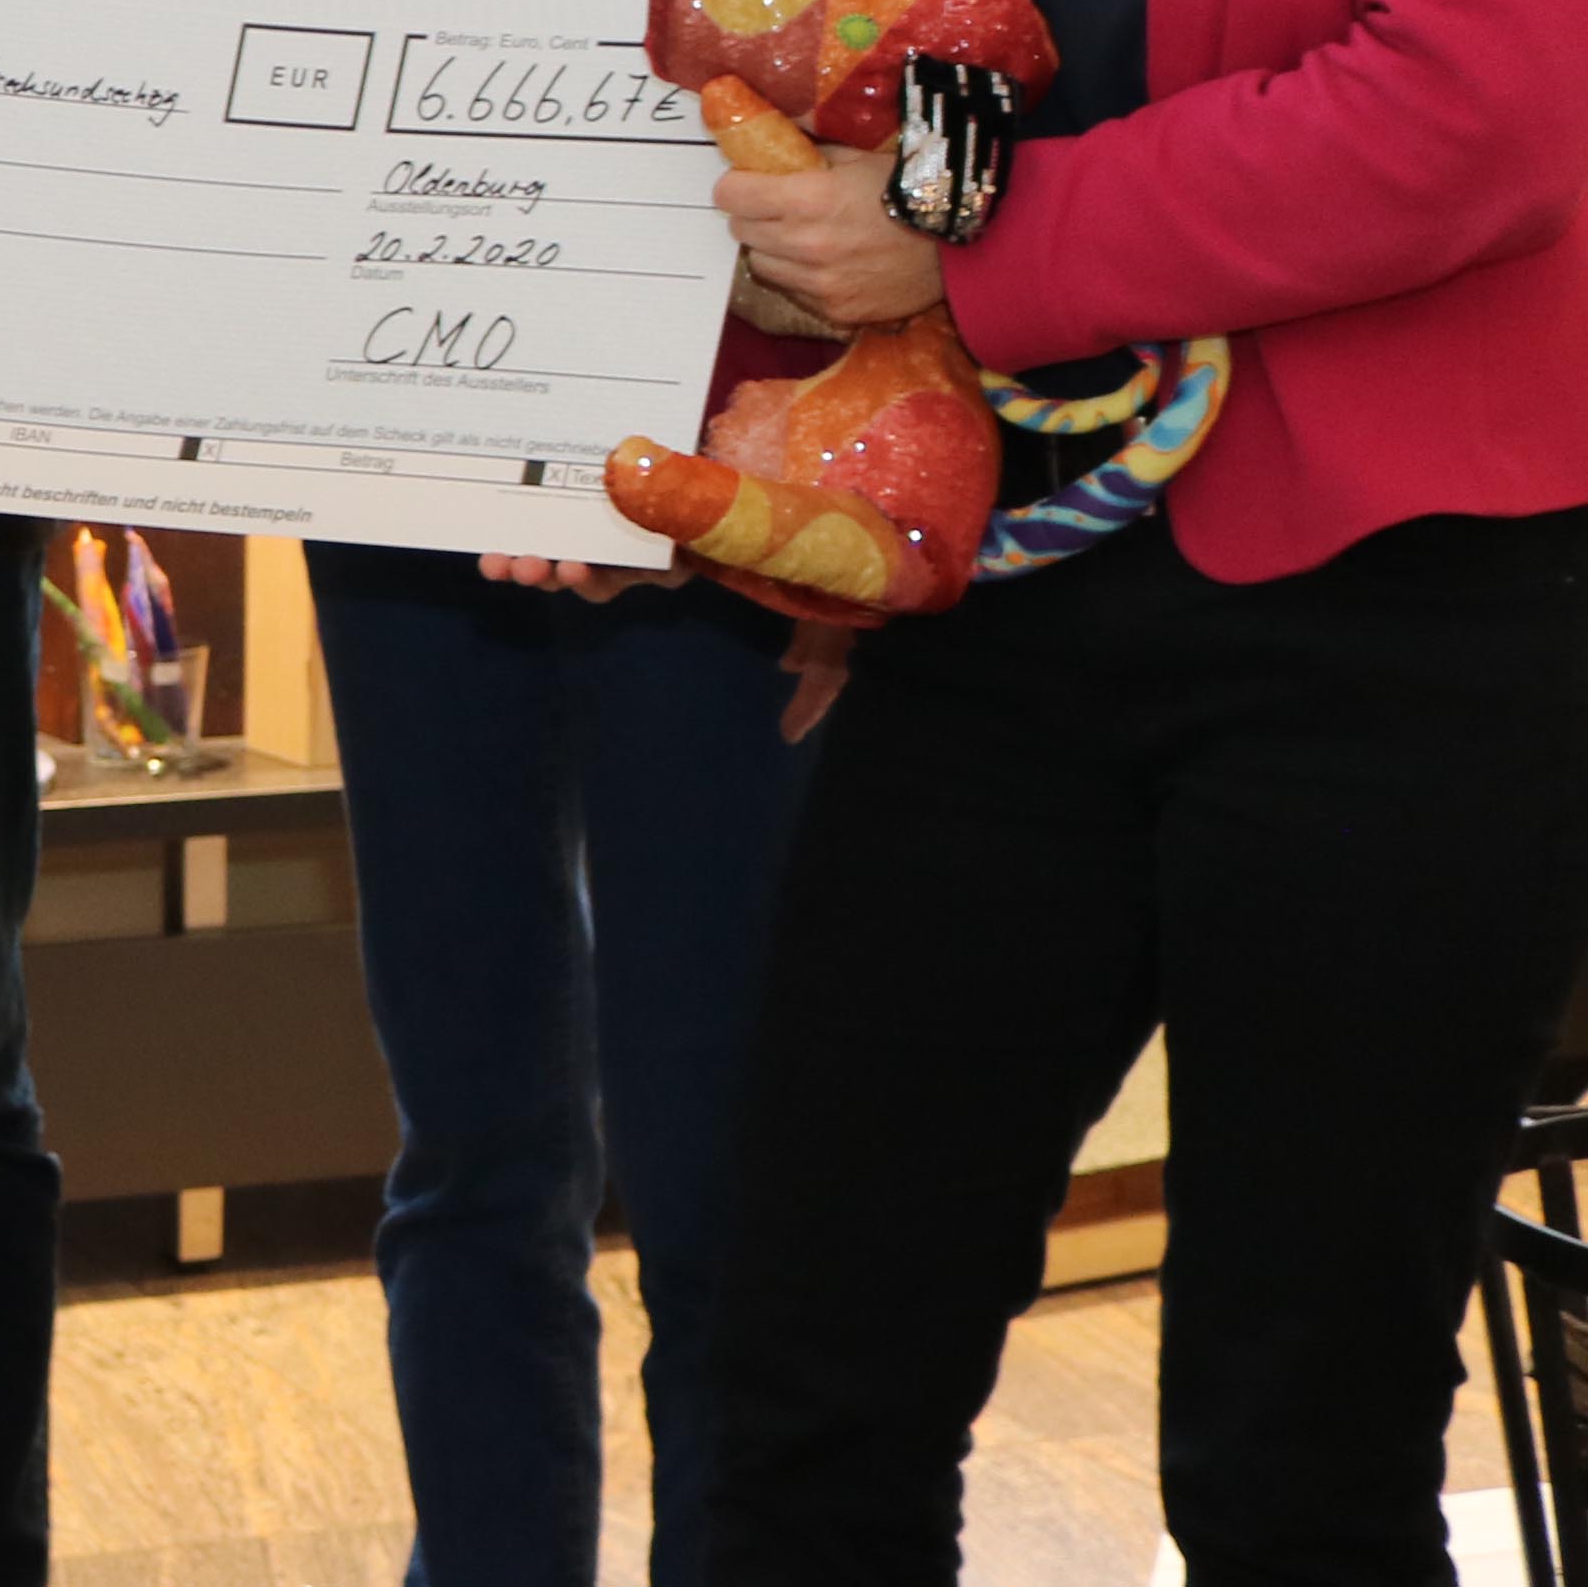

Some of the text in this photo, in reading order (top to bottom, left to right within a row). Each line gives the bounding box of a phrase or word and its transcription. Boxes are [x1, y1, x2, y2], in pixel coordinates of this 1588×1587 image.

[268, 66, 329, 90] EUR
[384, 160, 548, 214] Oldenburg
[350, 265, 404, 281] Datum
[362, 305, 516, 370] CMO
[325, 365, 551, 396] Unterschrift des Ausstellers
[10, 426, 52, 444] IBAN
[203, 442, 216, 456] X
[339, 451, 394, 473] Betrag
[548, 466, 561, 481] X
[21, 481, 119, 507] beschriften
[123, 495, 157, 511] und
[160, 498, 207, 515] nicht
[210, 501, 313, 524] bestempeln
